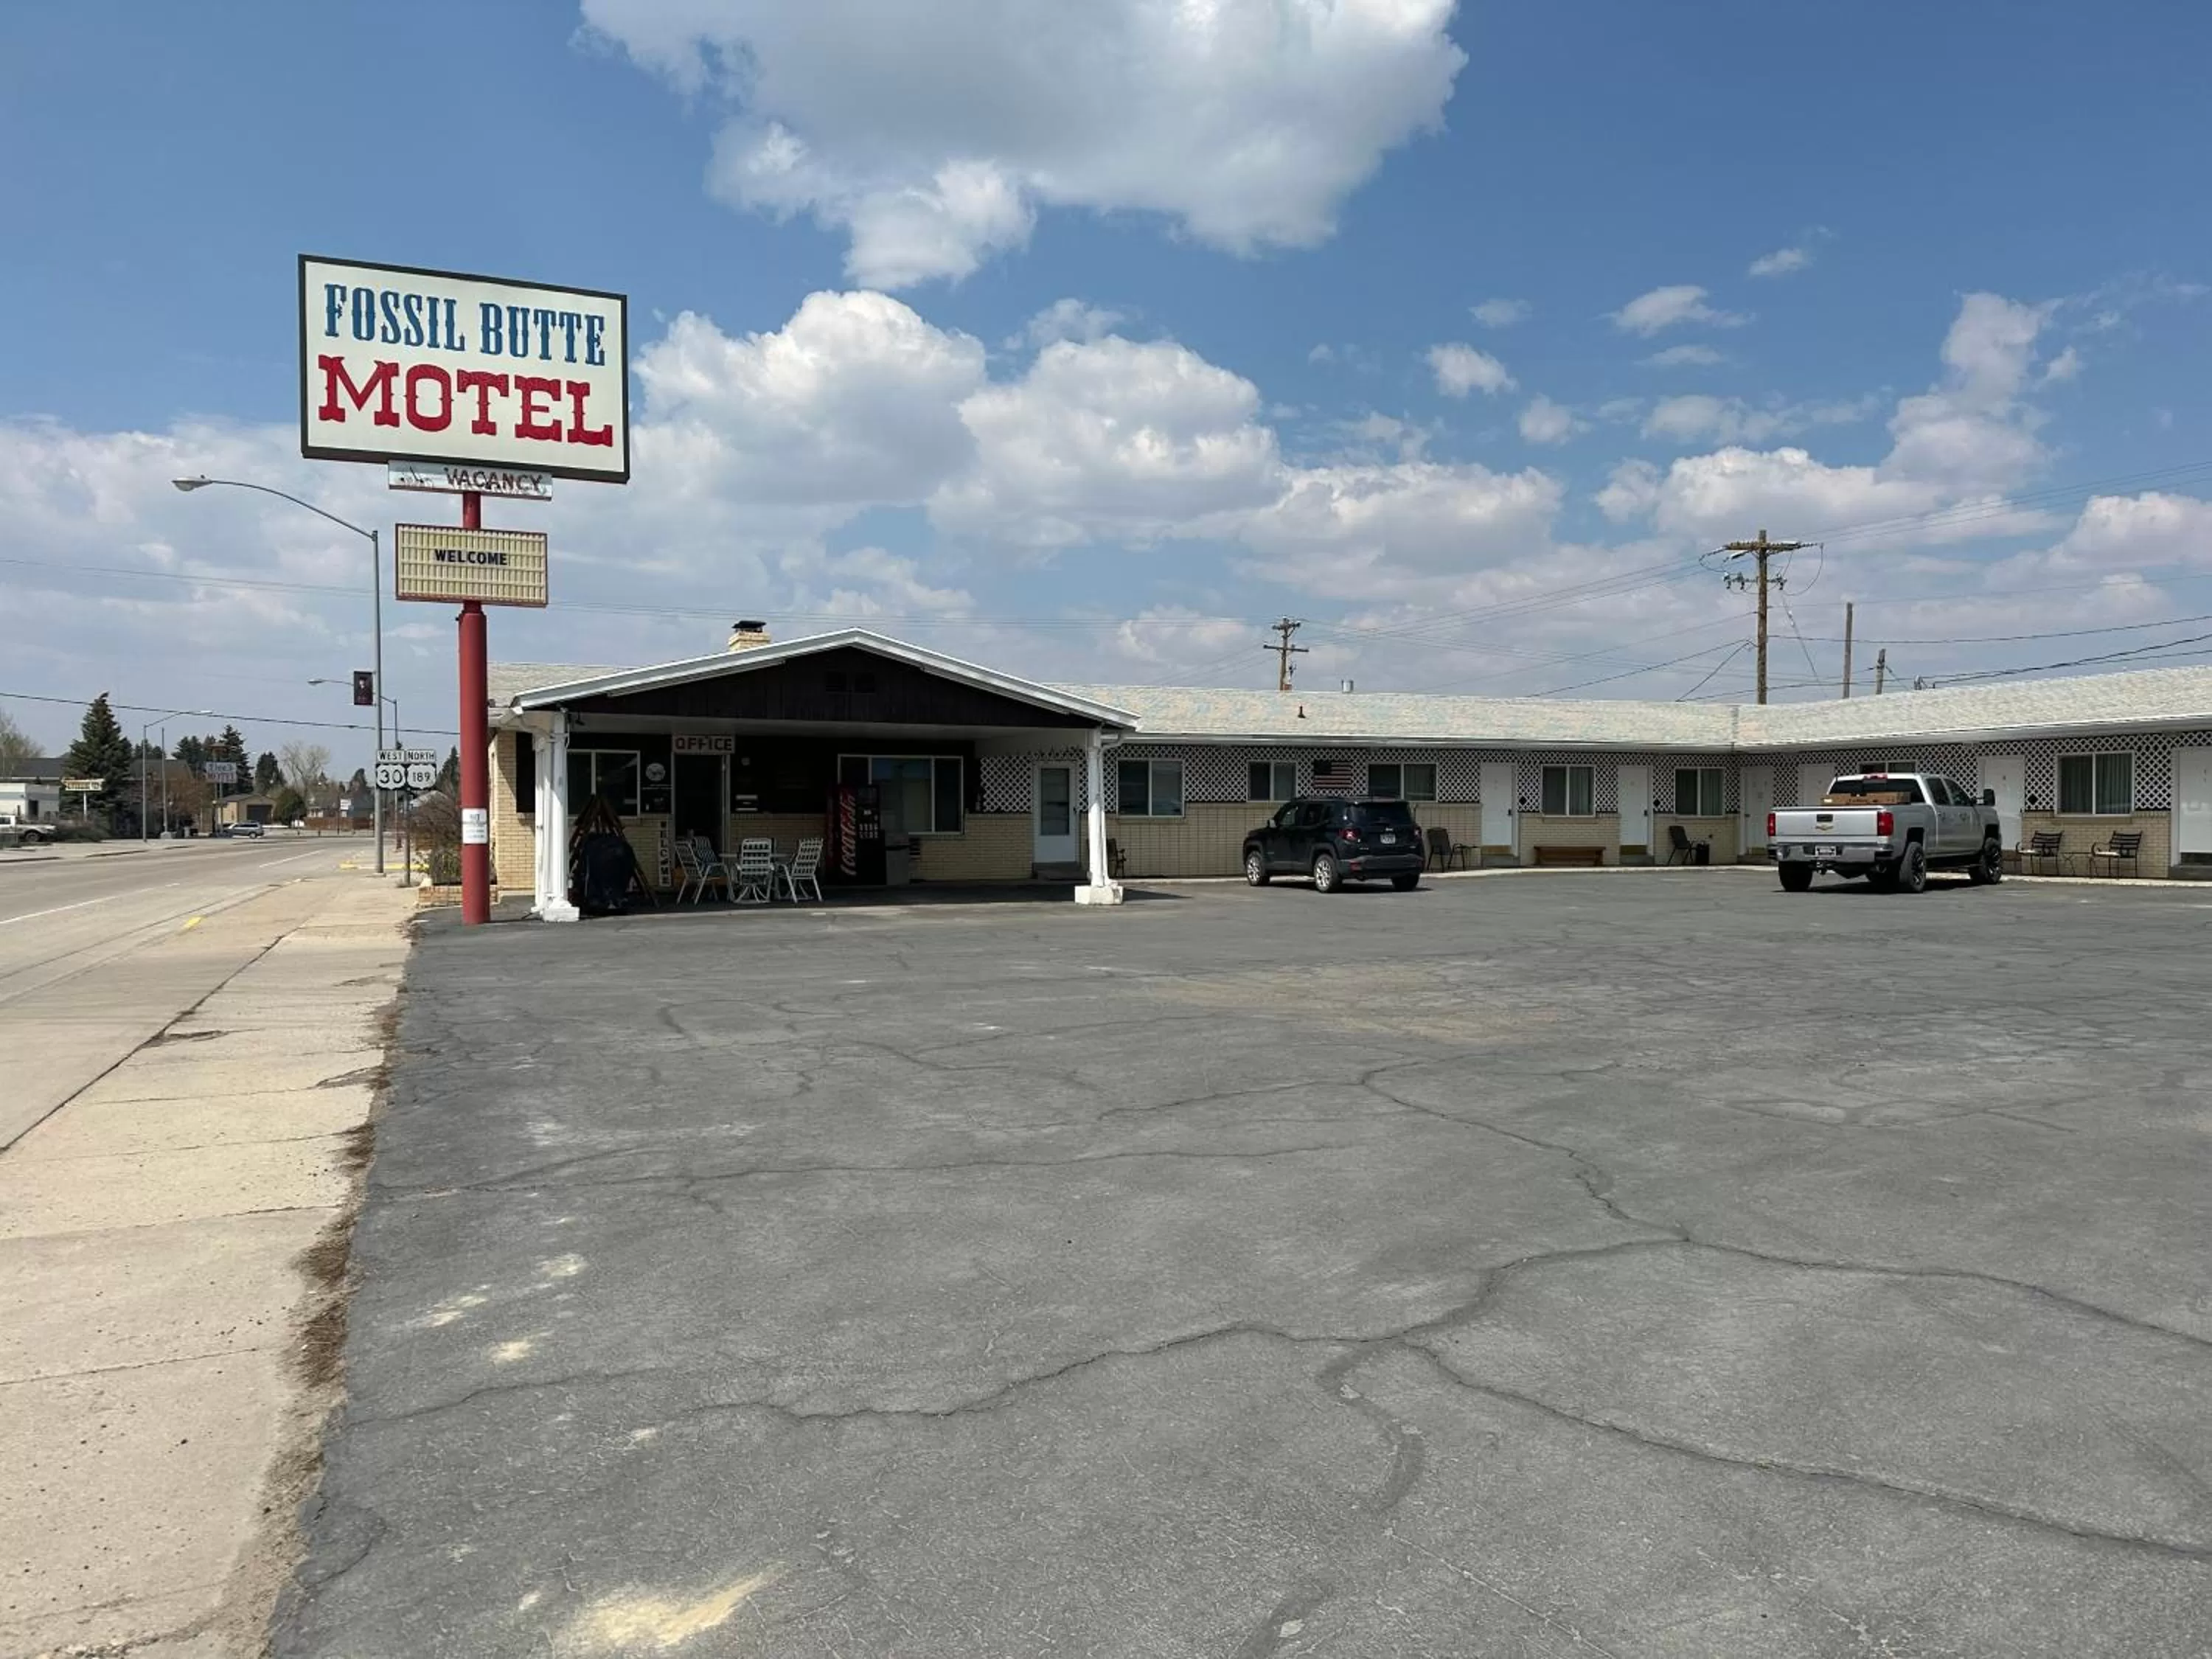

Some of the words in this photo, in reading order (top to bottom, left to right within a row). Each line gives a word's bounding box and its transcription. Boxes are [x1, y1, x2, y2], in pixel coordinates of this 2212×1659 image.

[324, 283, 465, 352] FOSSIL
[479, 302, 606, 366] BUTTE
[318, 354, 614, 448] MOTEL
[445, 467, 543, 492] VACANCY
[434, 548, 507, 566] WELCOME
[675, 737, 732, 751] OFFICE
[379, 751, 402, 760] WEST
[408, 751, 434, 760] NORTH
[379, 769, 403, 784] 30
[412, 771, 431, 782] 189
